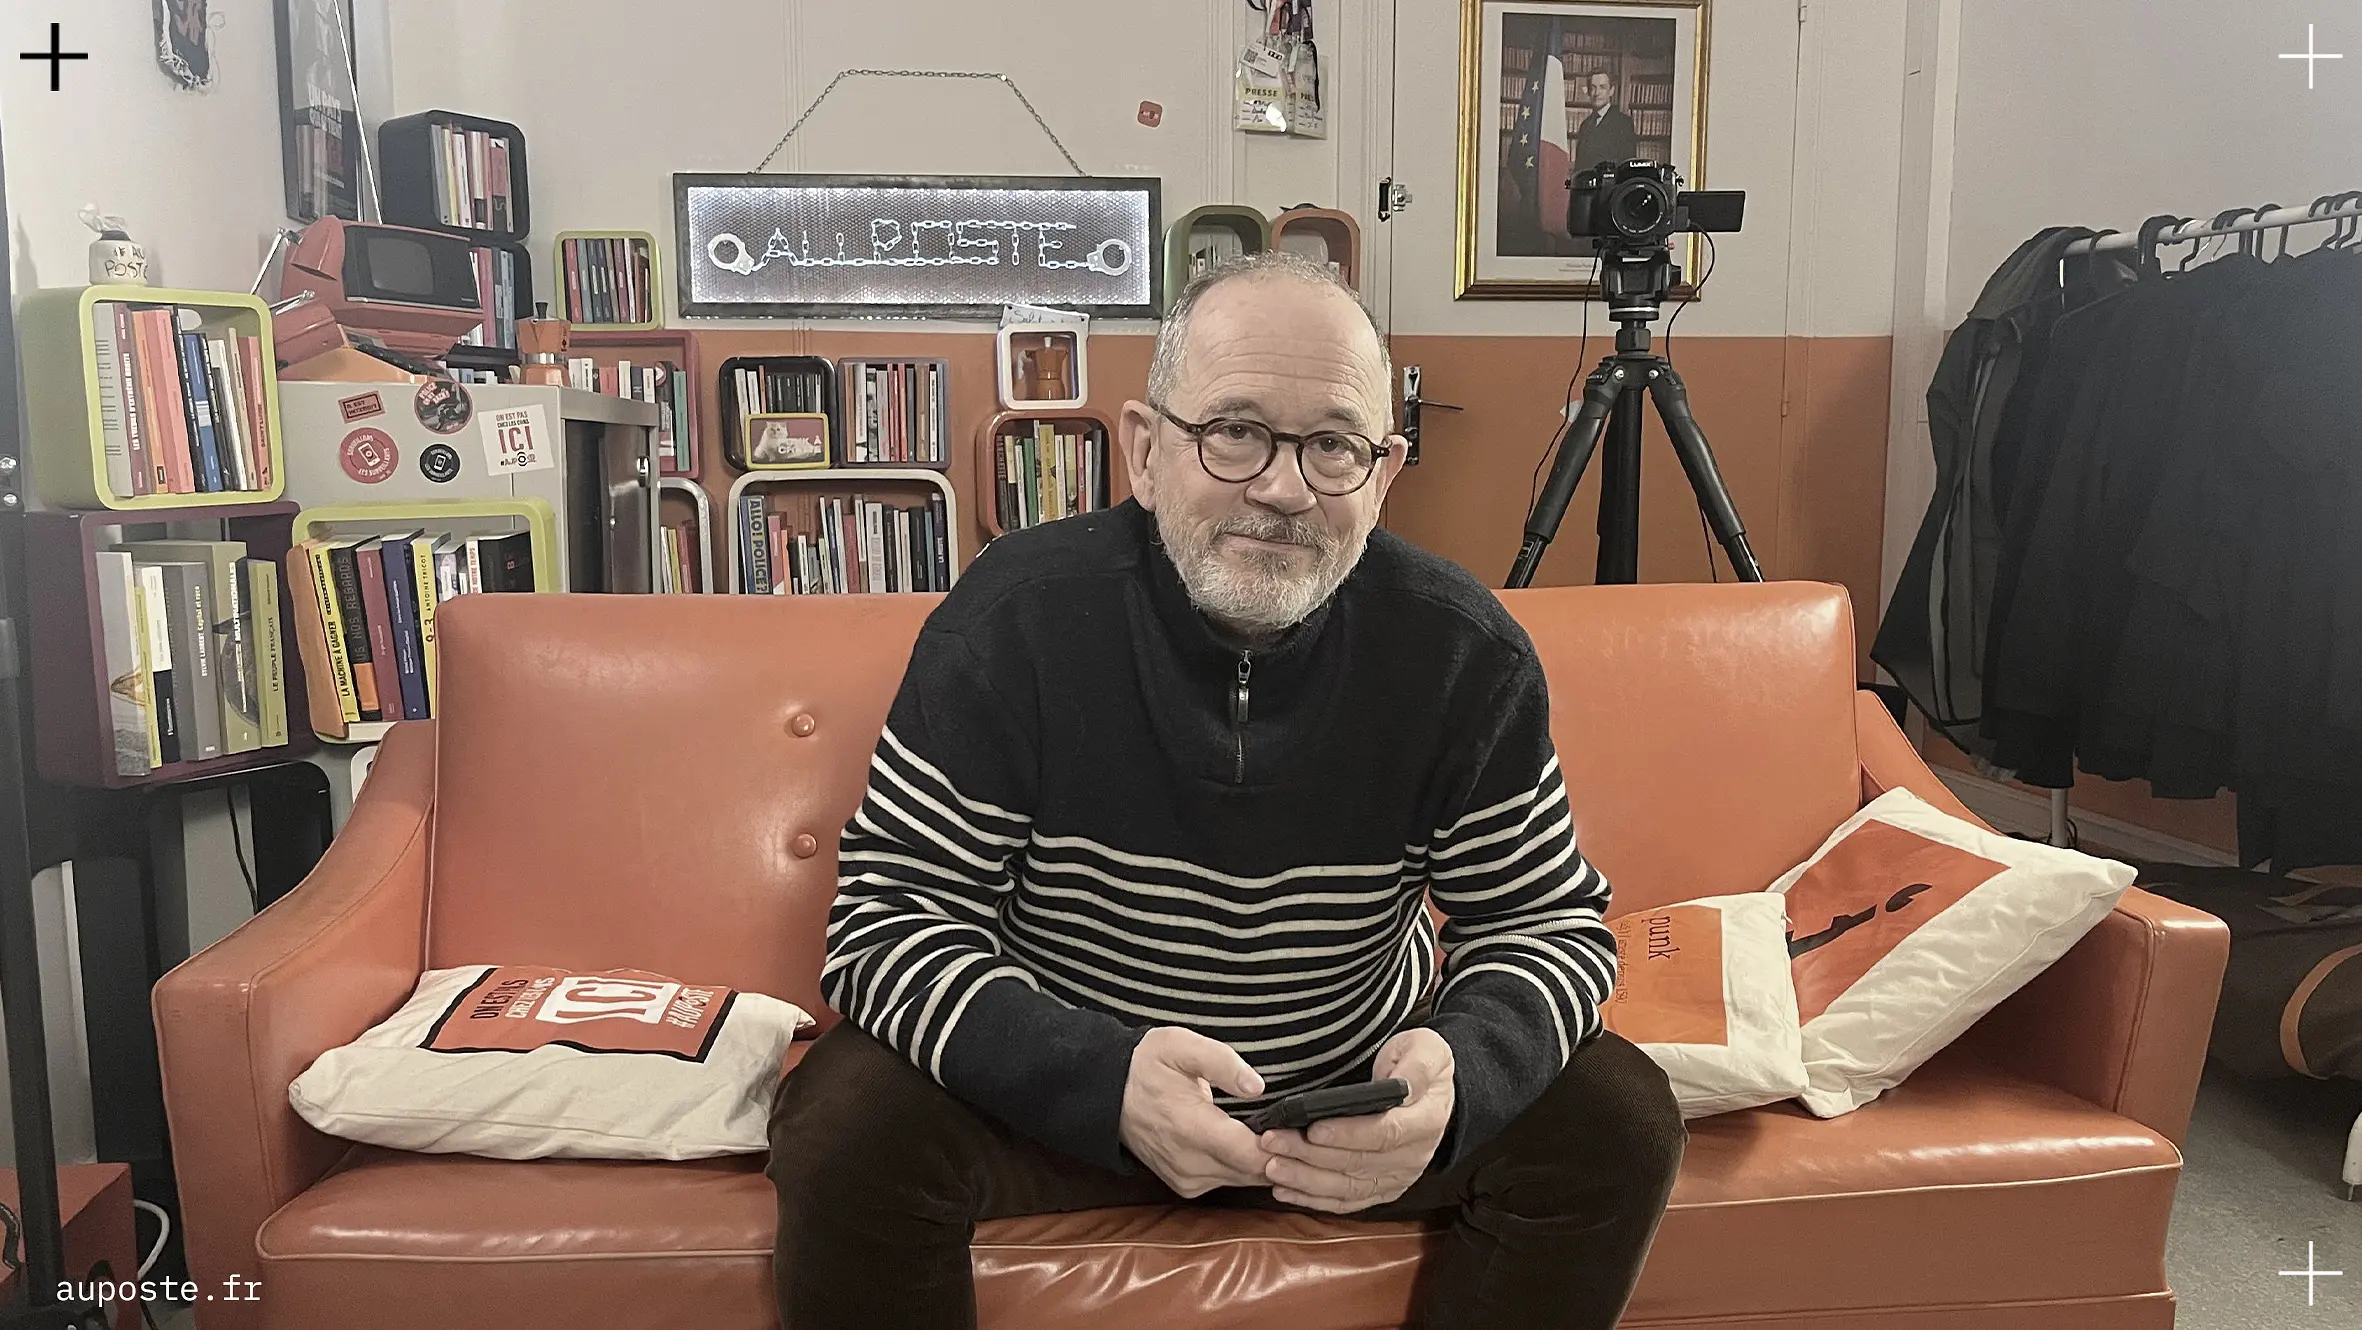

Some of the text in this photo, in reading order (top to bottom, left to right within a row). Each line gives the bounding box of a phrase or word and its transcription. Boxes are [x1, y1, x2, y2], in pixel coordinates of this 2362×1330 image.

[1245, 88, 1279, 97] PRESSE
[505, 412, 516, 420] EST
[516, 410, 529, 419] PAS
[498, 425, 534, 454] ICI
[750, 500, 768, 593] ALLO! POLICE?
[420, 554, 430, 578] TRICOT
[337, 557, 358, 610] REGARDS
[422, 580, 432, 611] ANTOINE
[328, 621, 341, 648] GAGNER
[270, 650, 278, 680] PEUPLE
[335, 655, 348, 687] MACHINE
[340, 687, 350, 697] LA
[1641, 915, 1681, 961] punk
[555, 979, 664, 1018] ICI
